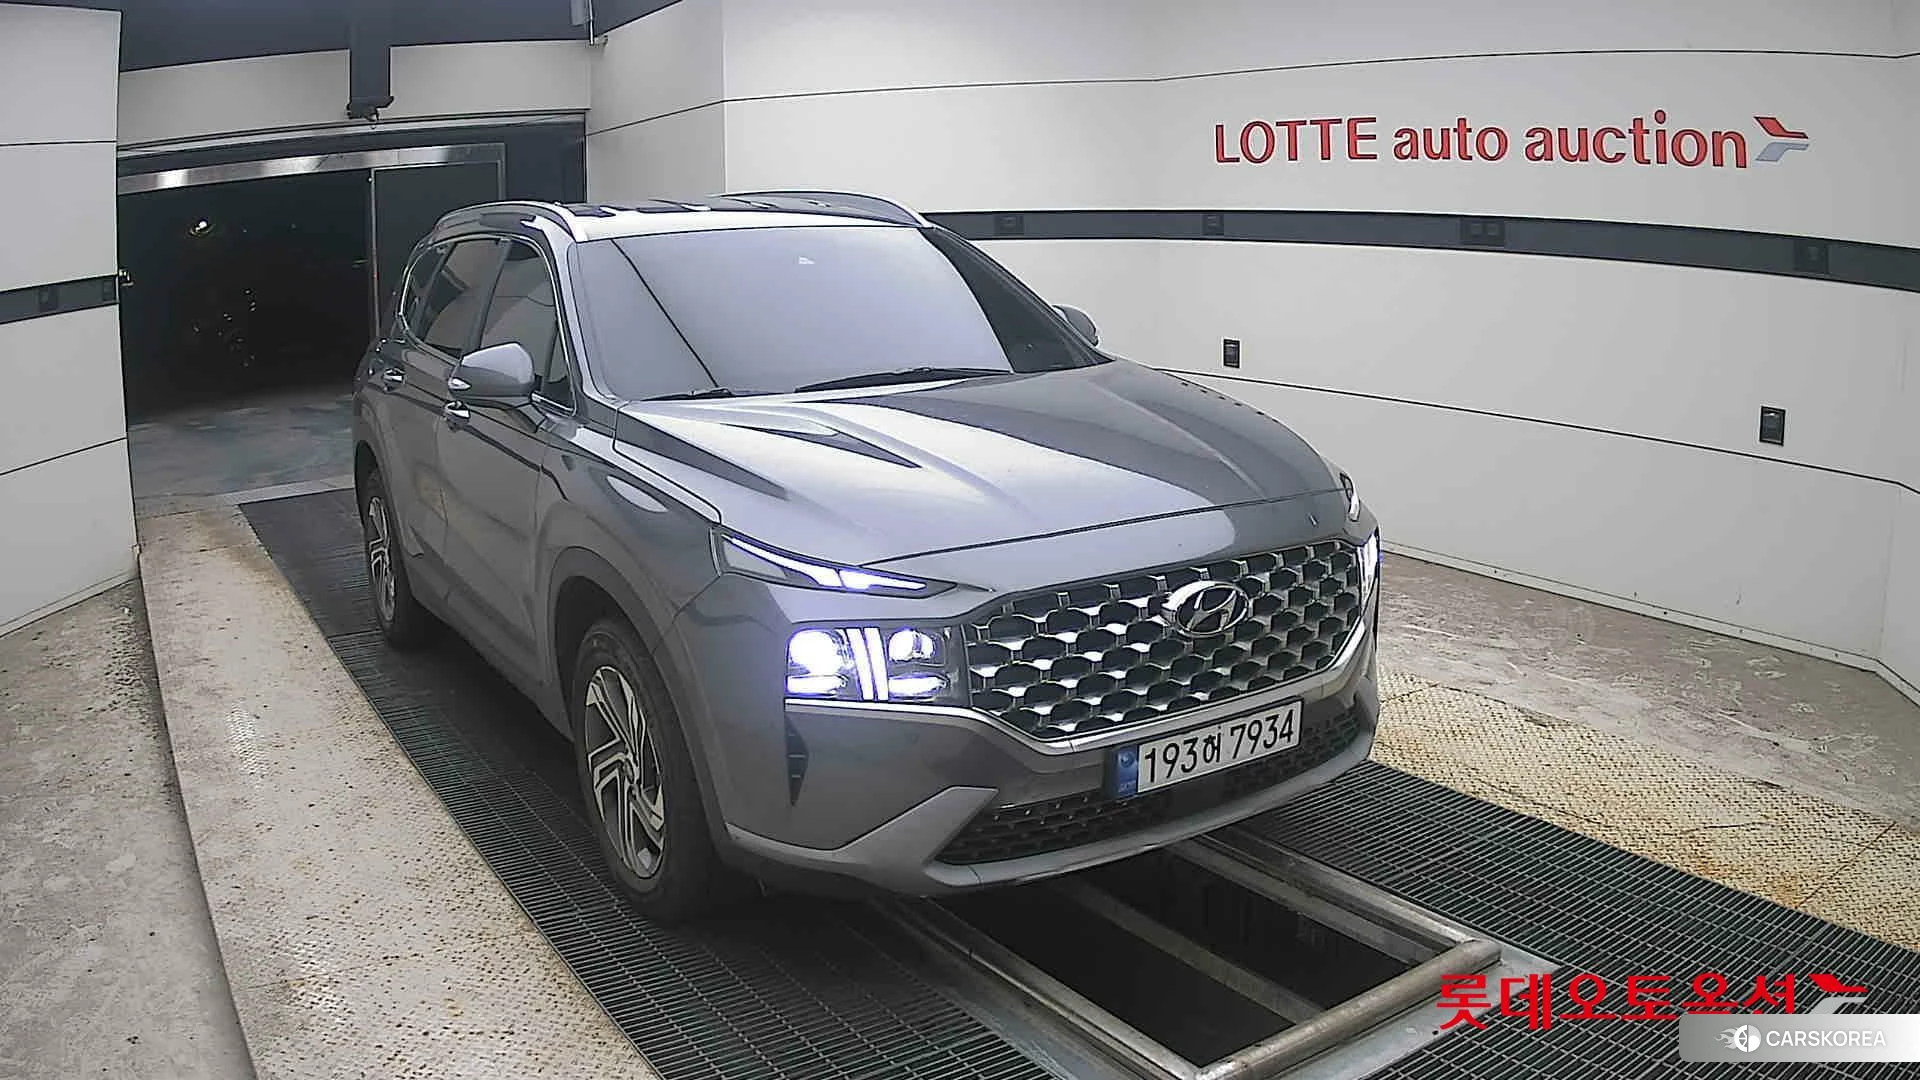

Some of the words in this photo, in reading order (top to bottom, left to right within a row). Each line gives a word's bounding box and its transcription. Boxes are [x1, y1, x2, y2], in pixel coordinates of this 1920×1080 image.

[1215, 117, 1378, 163] LOTTE
[1393, 117, 1509, 162] auto
[1524, 109, 1748, 169] auction
[1230, 709, 1294, 760] 7934
